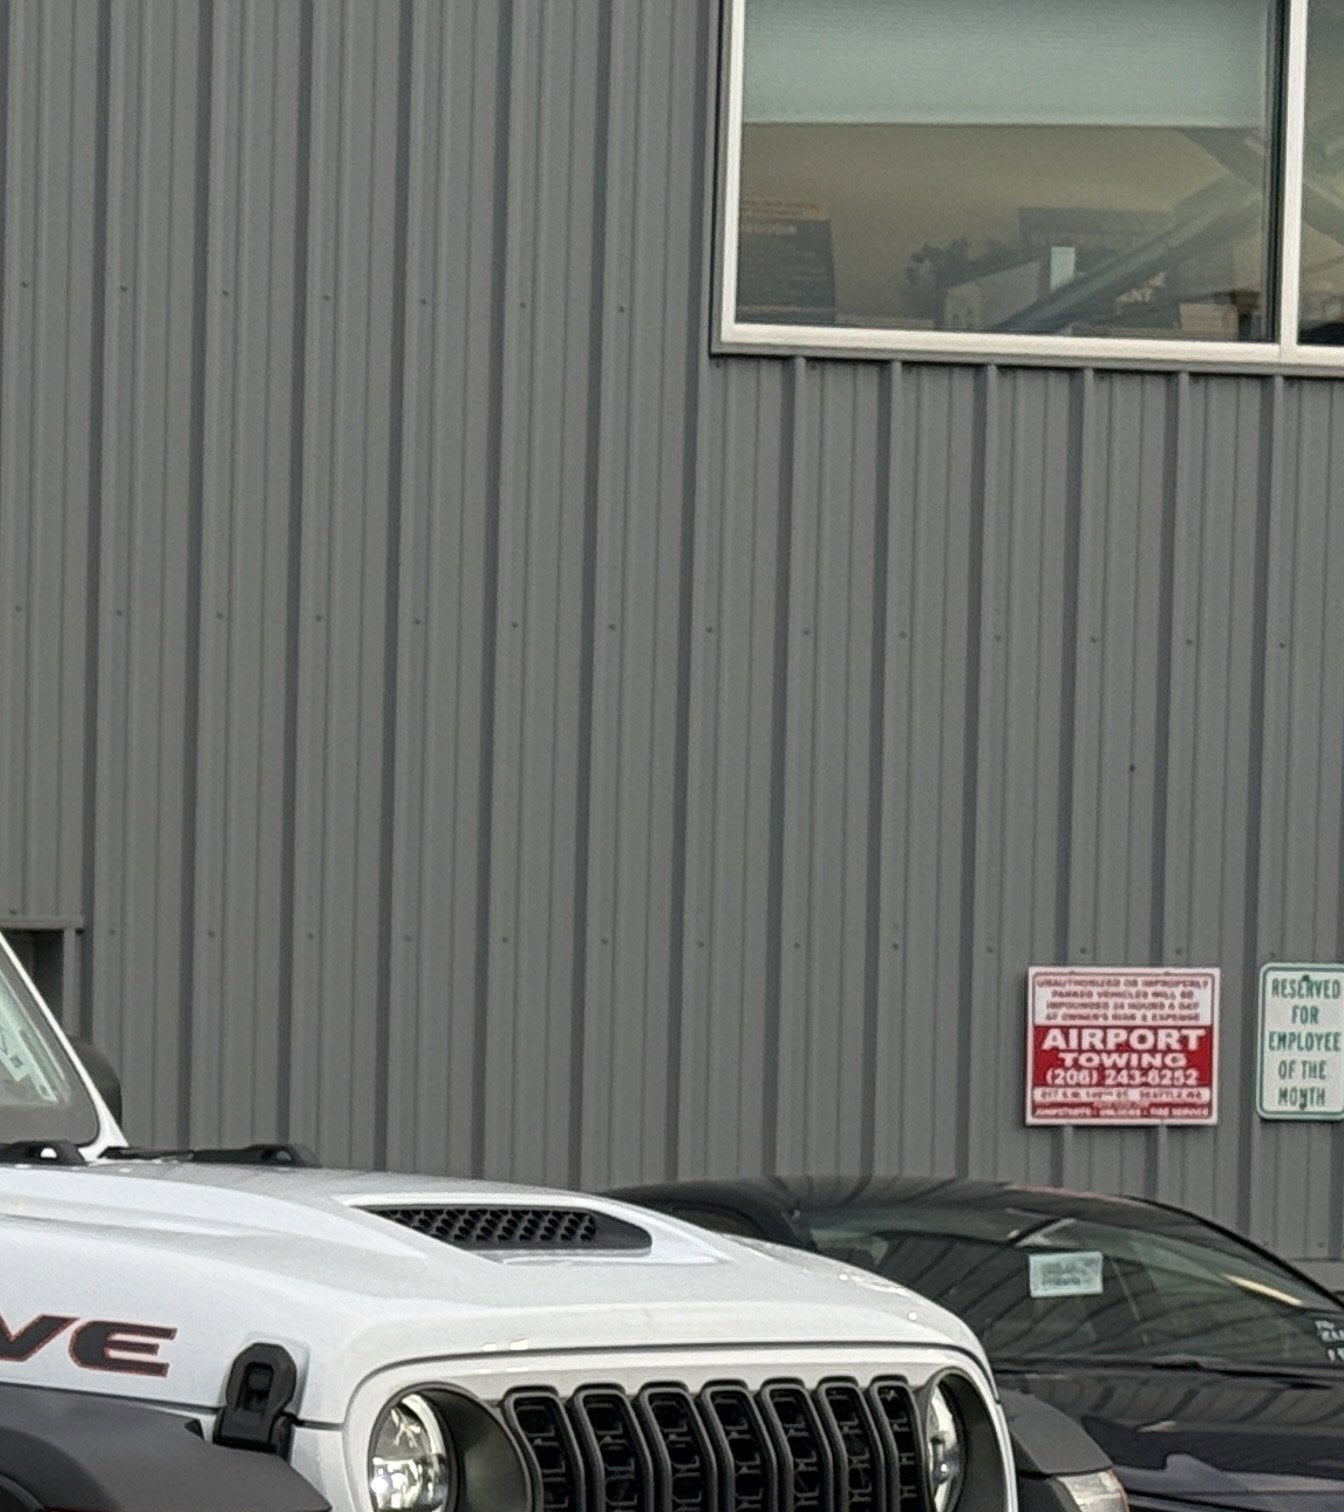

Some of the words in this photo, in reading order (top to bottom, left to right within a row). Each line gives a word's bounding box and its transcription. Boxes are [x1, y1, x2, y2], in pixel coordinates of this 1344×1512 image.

[1272, 977, 1341, 999] RESERVED
[1291, 1004, 1319, 1025] FOR
[1042, 1027, 1206, 1051] AIRPORT
[1268, 1031, 1341, 1052] EMPLOYEE
[1058, 1051, 1188, 1069] TOWING
[1278, 1059, 1295, 1080] OF
[1301, 1059, 1326, 1080] THE
[1045, 1068, 1098, 1086] (206)
[1278, 1086, 1326, 1107] MONTH
